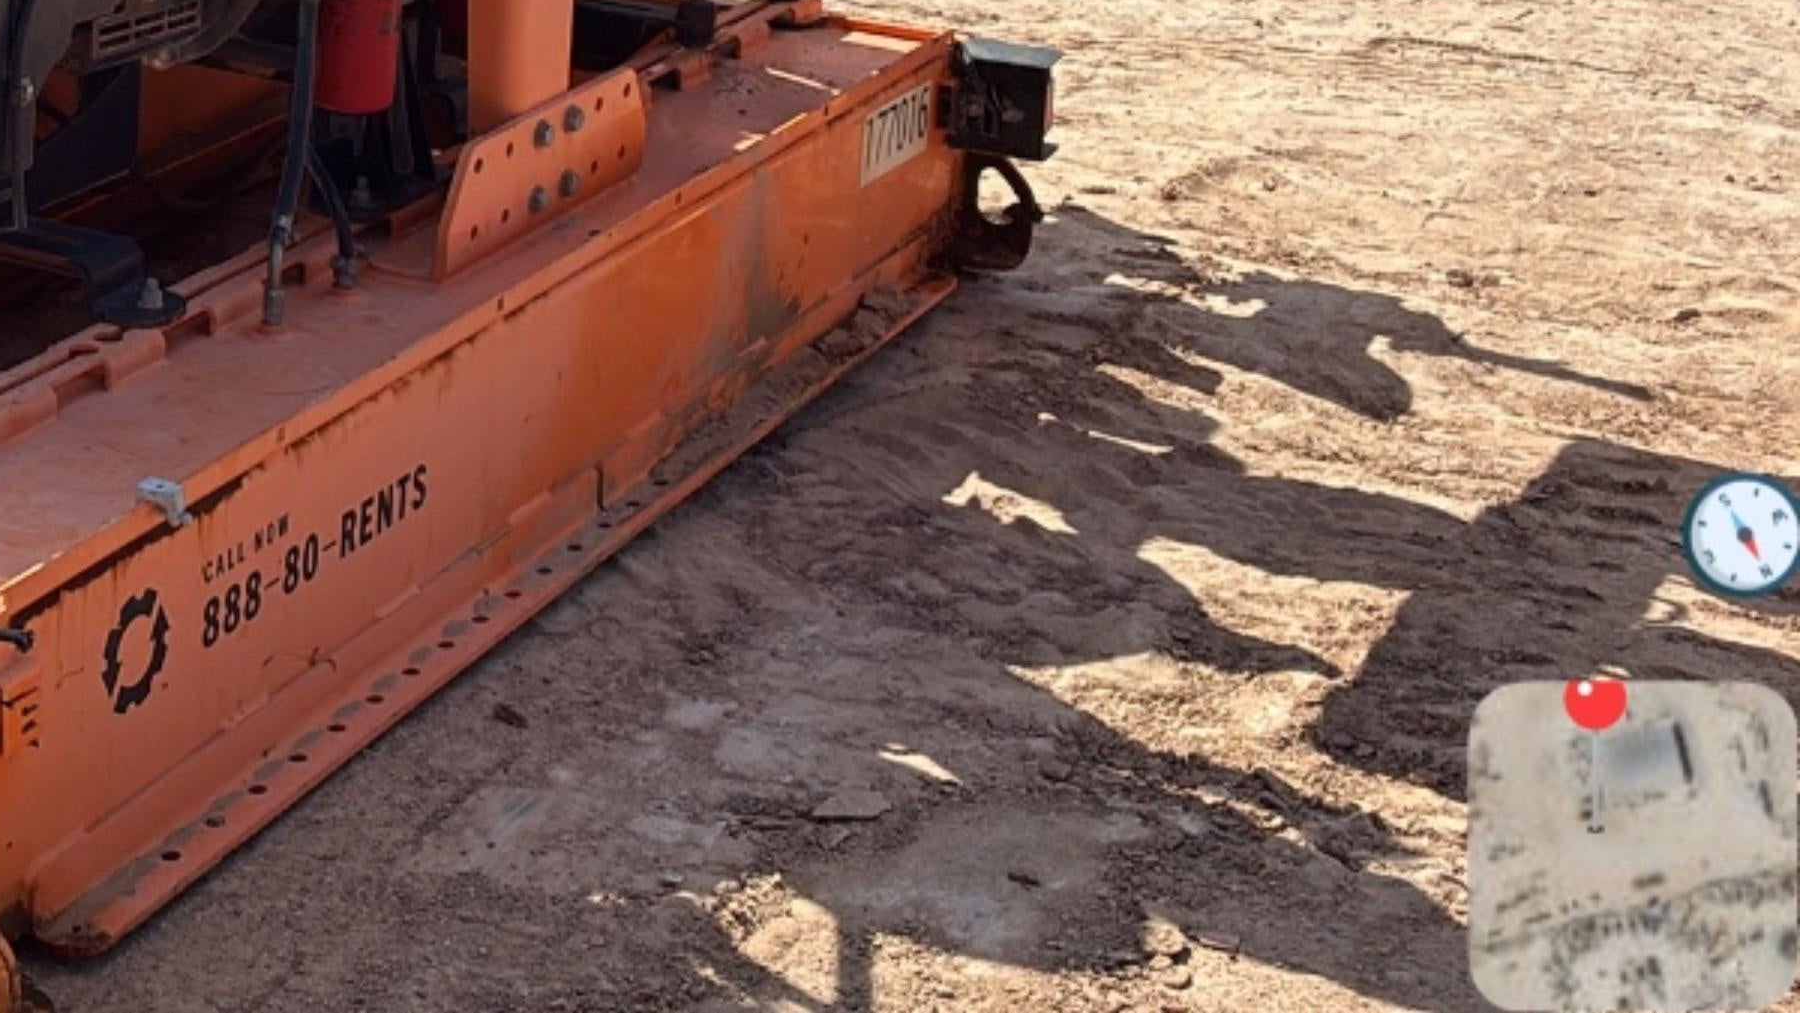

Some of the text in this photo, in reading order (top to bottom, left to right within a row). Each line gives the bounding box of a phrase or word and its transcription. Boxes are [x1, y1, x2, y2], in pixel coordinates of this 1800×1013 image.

[864, 86, 930, 171] 177016
[201, 511, 290, 585] CALL NOW
[202, 463, 428, 648] 888-80-RENTS
